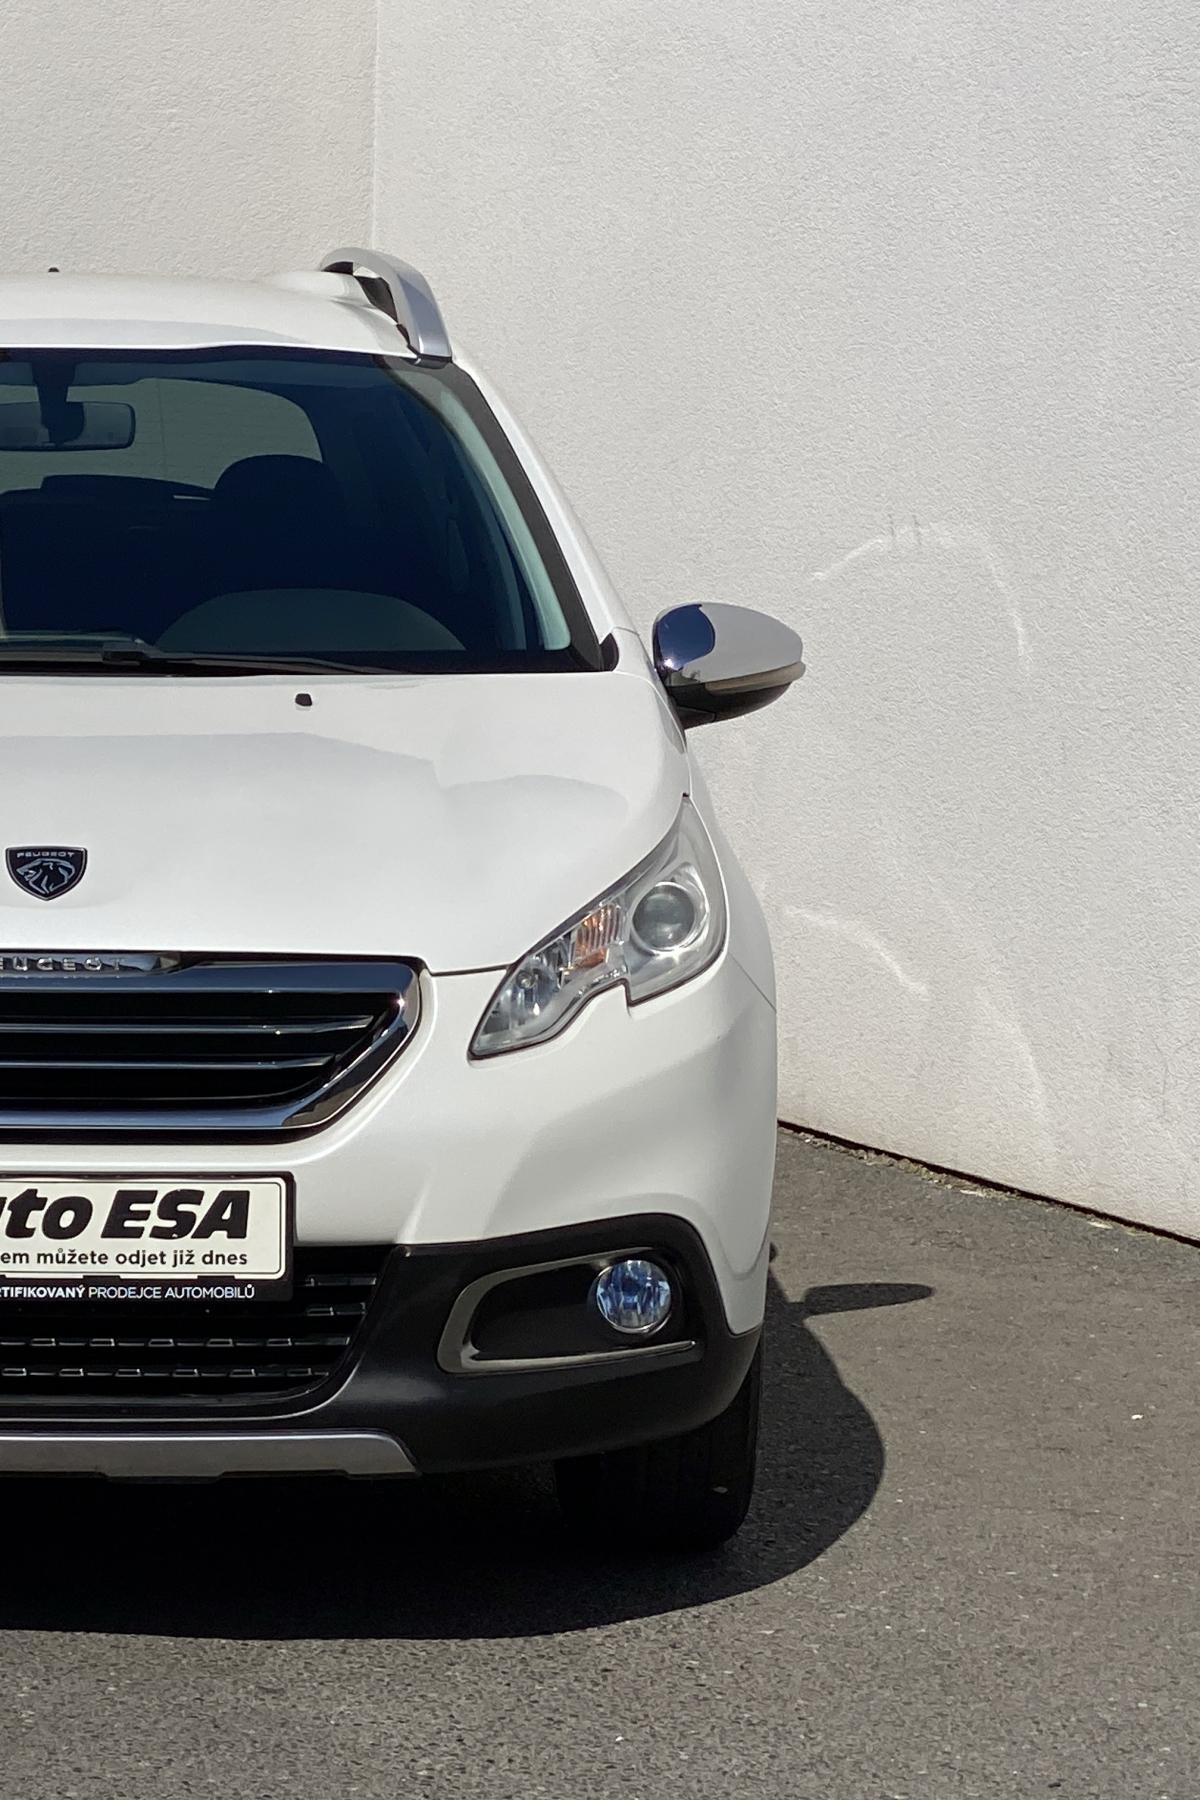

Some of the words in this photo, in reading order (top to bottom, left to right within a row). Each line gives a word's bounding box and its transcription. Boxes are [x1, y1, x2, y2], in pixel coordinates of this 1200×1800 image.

[101, 1190, 251, 1240] ESA
[36, 1248, 109, 1265] můžete
[116, 1248, 166, 1268] odjet
[171, 1248, 195, 1268] již
[201, 1249, 248, 1266] dnes
[88, 1287, 162, 1300] PRODEJCE
[164, 1284, 255, 1300] AUTOMOBILŮ
